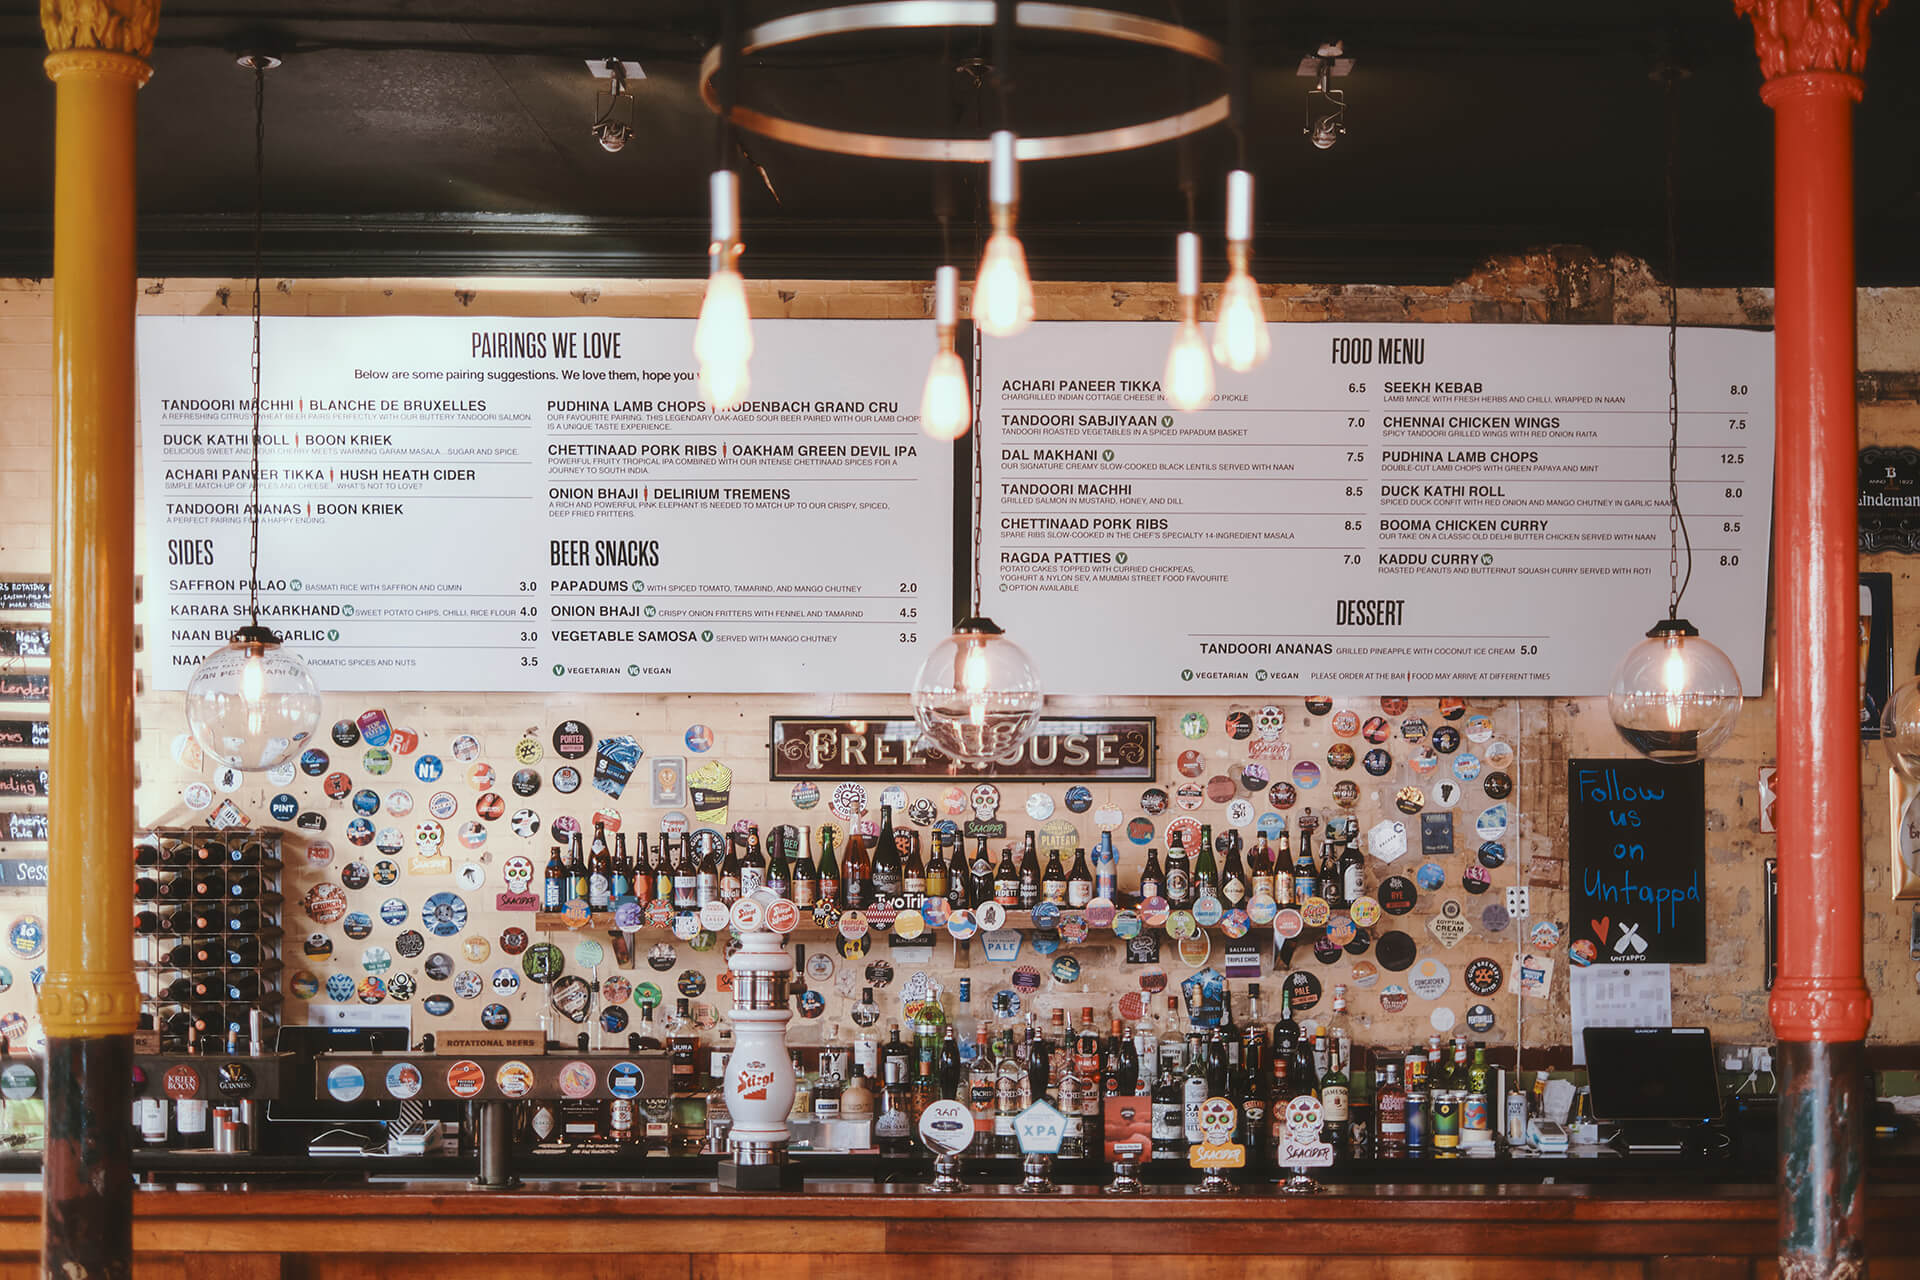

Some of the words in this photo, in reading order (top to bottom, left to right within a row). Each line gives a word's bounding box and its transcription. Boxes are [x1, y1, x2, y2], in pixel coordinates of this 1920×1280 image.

[472, 332, 546, 358] PAIRINGS
[552, 332, 577, 358] WE
[584, 332, 621, 359] LOVE
[1332, 338, 1372, 364] FOOD
[1378, 338, 1424, 365] MENU
[355, 369, 388, 379] Below
[446, 370, 484, 382] pairing
[487, 369, 559, 382] suggestions.
[561, 370, 580, 380] We
[583, 370, 606, 380] love
[608, 370, 639, 382] them,
[642, 370, 671, 383] hope
[673, 372, 694, 383] you
[1002, 380, 1054, 391] ACHARI
[1060, 380, 1115, 391] PANEER
[1120, 381, 1161, 392] TIKKA
[1349, 383, 1366, 393] 6.5
[1384, 382, 1430, 393] SEEKH
[1435, 382, 1482, 393] KEBAB
[1730, 385, 1748, 395] 8.0
[161, 400, 234, 411] TANDOORI
[310, 400, 376, 411] BLANCHE
[381, 400, 399, 410] DE
[404, 400, 486, 411] BRUXELLES
[548, 401, 609, 411] PUDHINA
[614, 401, 653, 412] LAMB
[657, 401, 706, 412] CHOPS
[721, 402, 810, 413] ODENBACH
[815, 402, 864, 413] GRAND
[869, 402, 898, 413] CRU
[1002, 415, 1074, 426] TANDOORI
[1078, 415, 1156, 427] SABJIYAAN
[1348, 418, 1365, 428] 7.0
[1383, 417, 1444, 428] CHENNAI
[1449, 417, 1510, 428] CHICKEN
[1514, 417, 1560, 428] WINGS
[1729, 420, 1746, 430] 7.5
[164, 434, 202, 445] DUCK
[207, 435, 248, 445] KATHI
[306, 435, 345, 445] BOON
[351, 435, 392, 445] KRIEK
[548, 444, 637, 455] CHETTINAAD
[642, 445, 680, 456] PORK
[685, 445, 717, 456] RIBS
[733, 445, 793, 456] OAKHAM
[798, 445, 846, 456] GREEN
[851, 446, 890, 456] DEVIL
[895, 446, 917, 456] IPA
[1002, 449, 1029, 460] DAL
[1034, 449, 1097, 460] MAKHANI
[1347, 452, 1364, 463] 7.5
[165, 469, 217, 480] ACHARI
[222, 469, 278, 481] PANER
[283, 470, 324, 480] TIKKA
[340, 469, 378, 480] HUSH
[383, 470, 429, 480] HEATH
[434, 470, 475, 480] CIDER
[549, 488, 593, 499] ONION
[598, 488, 638, 499] BHAJI
[654, 488, 719, 499] DELIRIUM
[723, 489, 790, 500] TREMENS
[166, 504, 238, 514] TANDOORI
[317, 504, 357, 515] BOON
[362, 504, 403, 514] KRIEK
[1380, 520, 1431, 531] BOOMA
[1435, 520, 1496, 531] CHICKEN
[1501, 520, 1548, 531] CURRY
[1723, 522, 1740, 532] 8.5
[168, 539, 213, 565] SIDES
[551, 540, 589, 566] BEER
[595, 540, 659, 566] SNACKS
[170, 580, 234, 590] SAFFRON
[240, 580, 287, 591] PULAO
[520, 582, 537, 591] 3.0
[551, 581, 628, 591] PAPADUMS
[900, 583, 917, 592] 2.0
[171, 605, 229, 616] KARARA
[233, 605, 340, 616] SHAKARKHAND
[520, 607, 537, 616] 4.0
[551, 605, 595, 616] ONION
[600, 606, 639, 616] BHAJI
[900, 608, 917, 618] 4.5
[1336, 600, 1405, 626] DESSERT
[1200, 643, 1271, 654] TANDOORI
[1275, 643, 1332, 654] ANANAS
[567, 667, 620, 676] VEGETARIAN
[1196, 672, 1249, 680] VEGETARIAN
[1270, 672, 1299, 680] VEGAN
[1311, 672, 1337, 680] PLEASE
[1338, 672, 1364, 680] ORDER
[1365, 672, 1374, 680] AT
[1375, 672, 1389, 680] THE
[1391, 672, 1406, 680] BAR
[1412, 672, 1434, 680] FOOD
[1435, 672, 1451, 680] MAY
[1452, 672, 1478, 680] ARRIVE
[1489, 672, 1528, 680] DIFFERENT
[1529, 672, 1551, 680] TIMES
[560, 735, 584, 744] PORTER
[806, 728, 927, 770] FREE
[1579, 768, 1665, 804] Follow
[273, 804, 295, 812] PINT
[1609, 809, 1642, 827] us
[1613, 843, 1645, 862] on
[1583, 867, 1701, 935] Untappd
[1435, 925, 1464, 933] CREAM
[988, 943, 1016, 951] PALE
[447, 1039, 504, 1047] ROTATIONAL
[506, 1039, 535, 1047] BEERS
[167, 1075, 196, 1083] KRIEK
[167, 1082, 197, 1091] BOON
[1024, 1125, 1057, 1137] XPA
